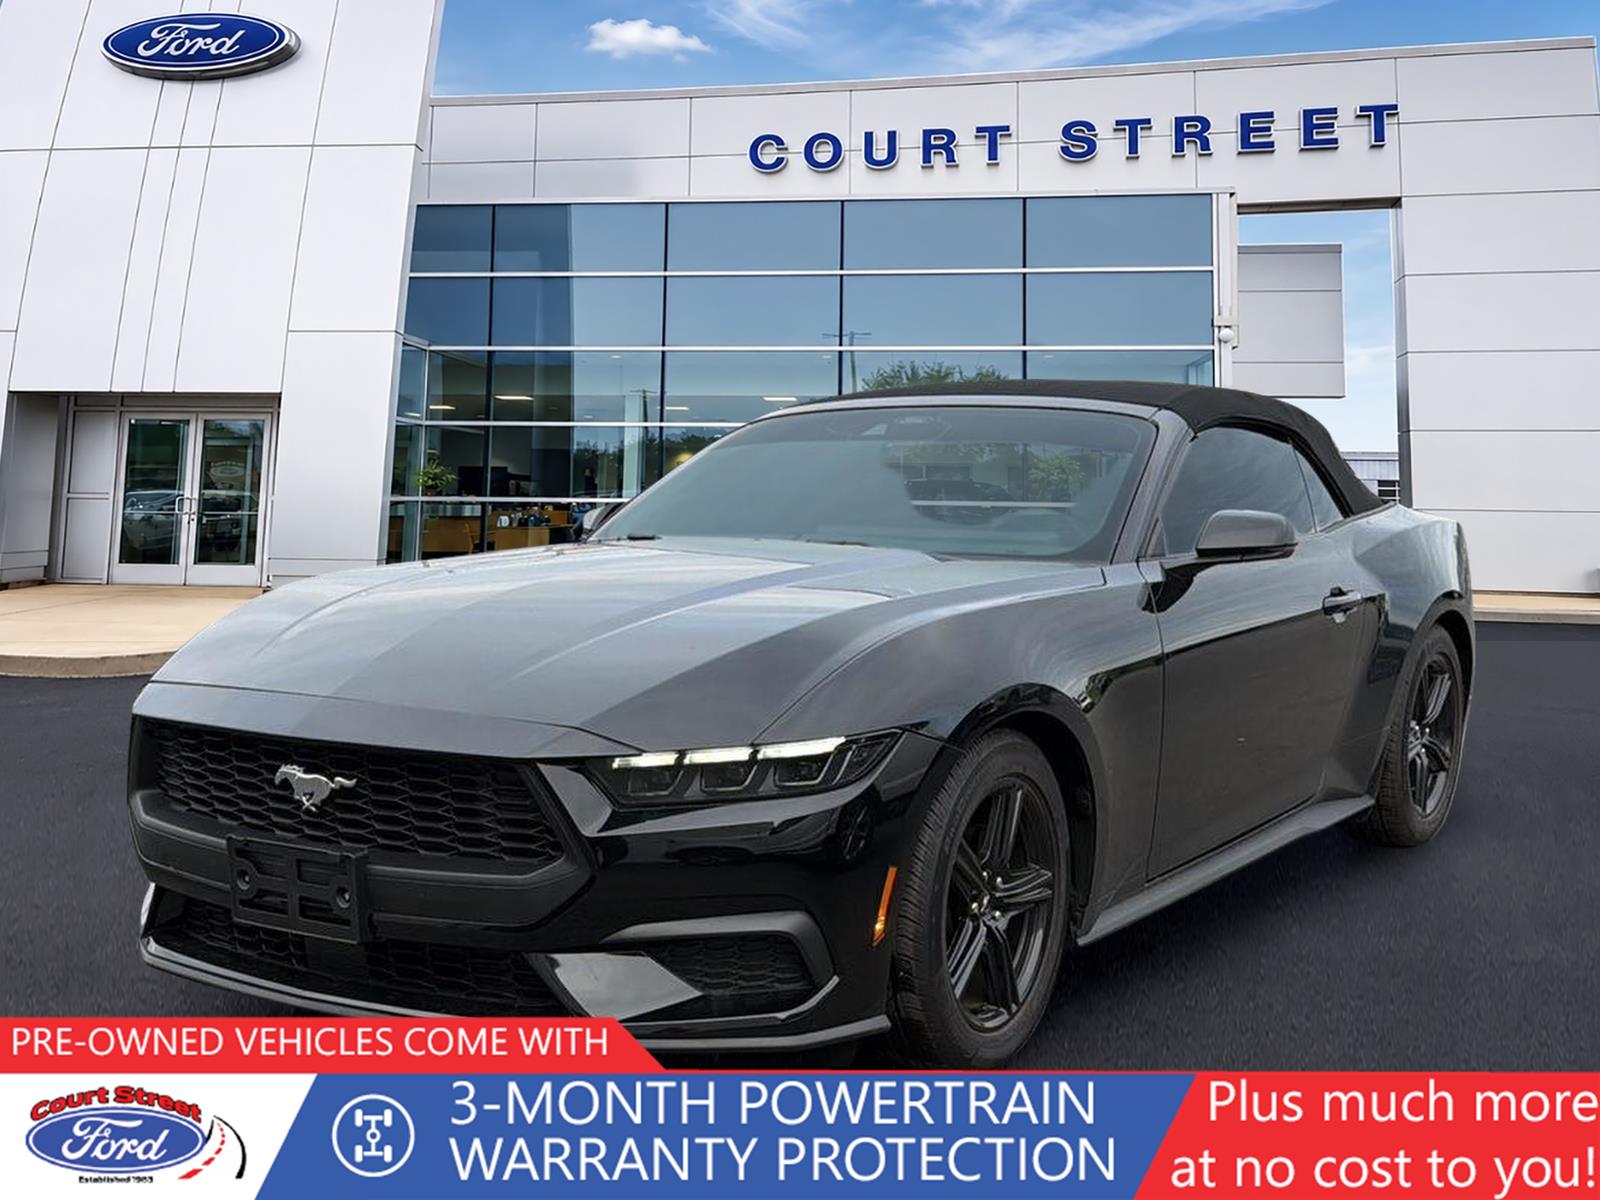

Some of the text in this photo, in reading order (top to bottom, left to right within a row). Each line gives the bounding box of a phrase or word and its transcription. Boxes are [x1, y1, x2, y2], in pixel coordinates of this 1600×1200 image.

[137, 23, 245, 56] Ford
[748, 103, 1399, 172] COURT STREET
